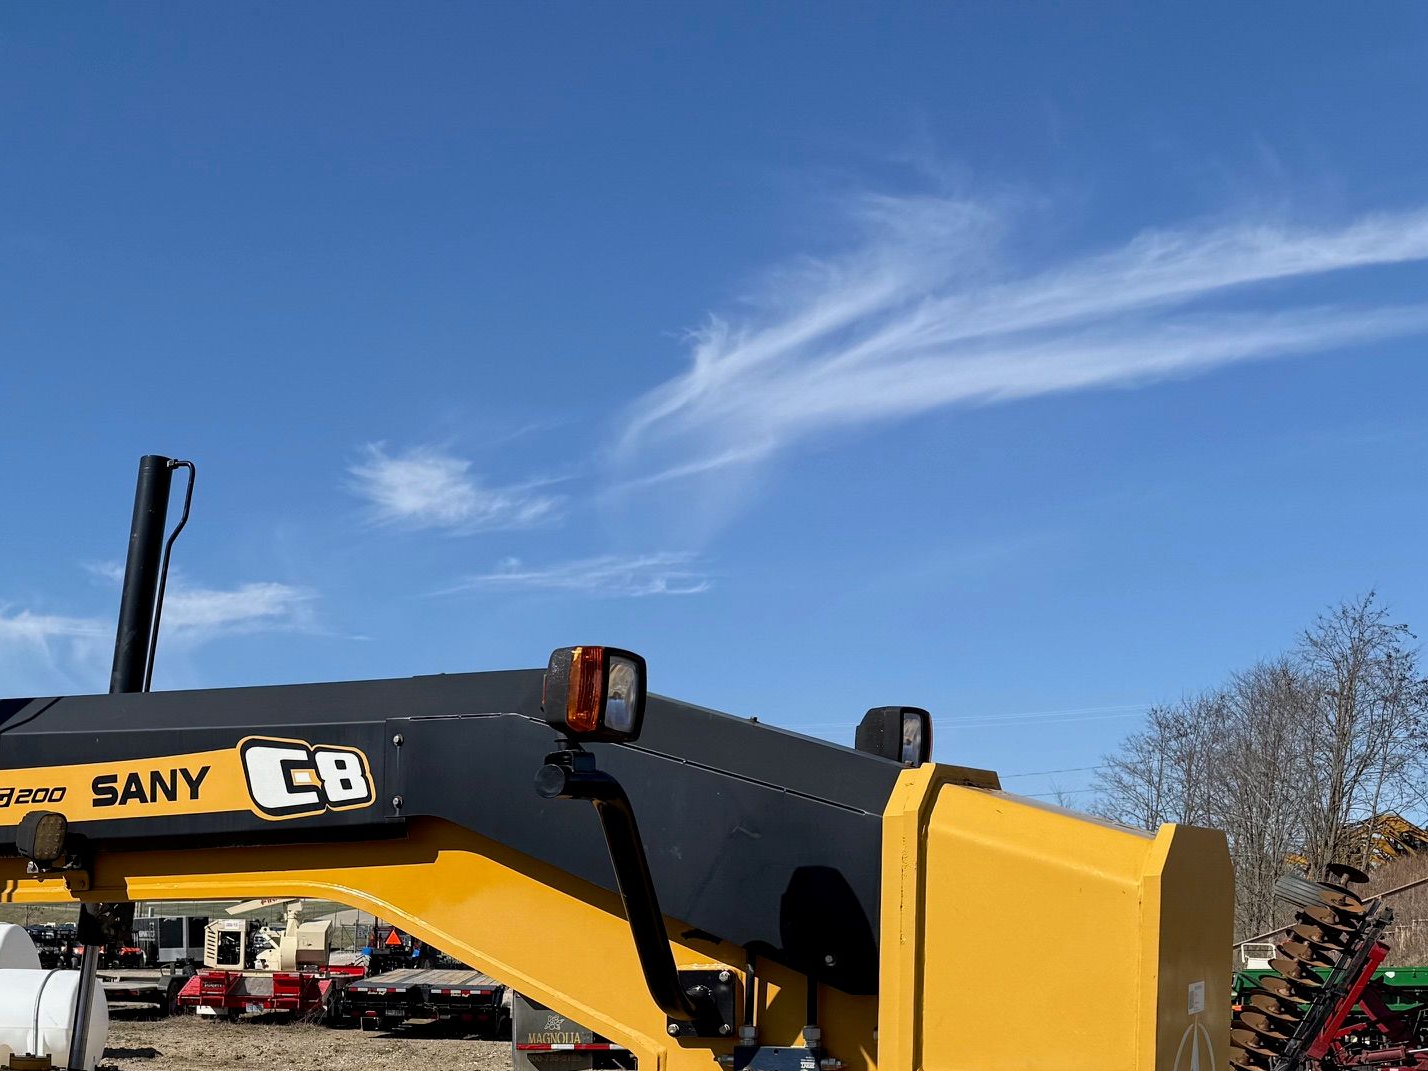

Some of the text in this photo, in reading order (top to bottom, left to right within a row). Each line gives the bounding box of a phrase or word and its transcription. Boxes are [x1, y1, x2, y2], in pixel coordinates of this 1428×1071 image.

[14, 787, 67, 804] 200
[92, 765, 211, 807] SANY
[527, 1032, 581, 1044] MAGNOLIA
